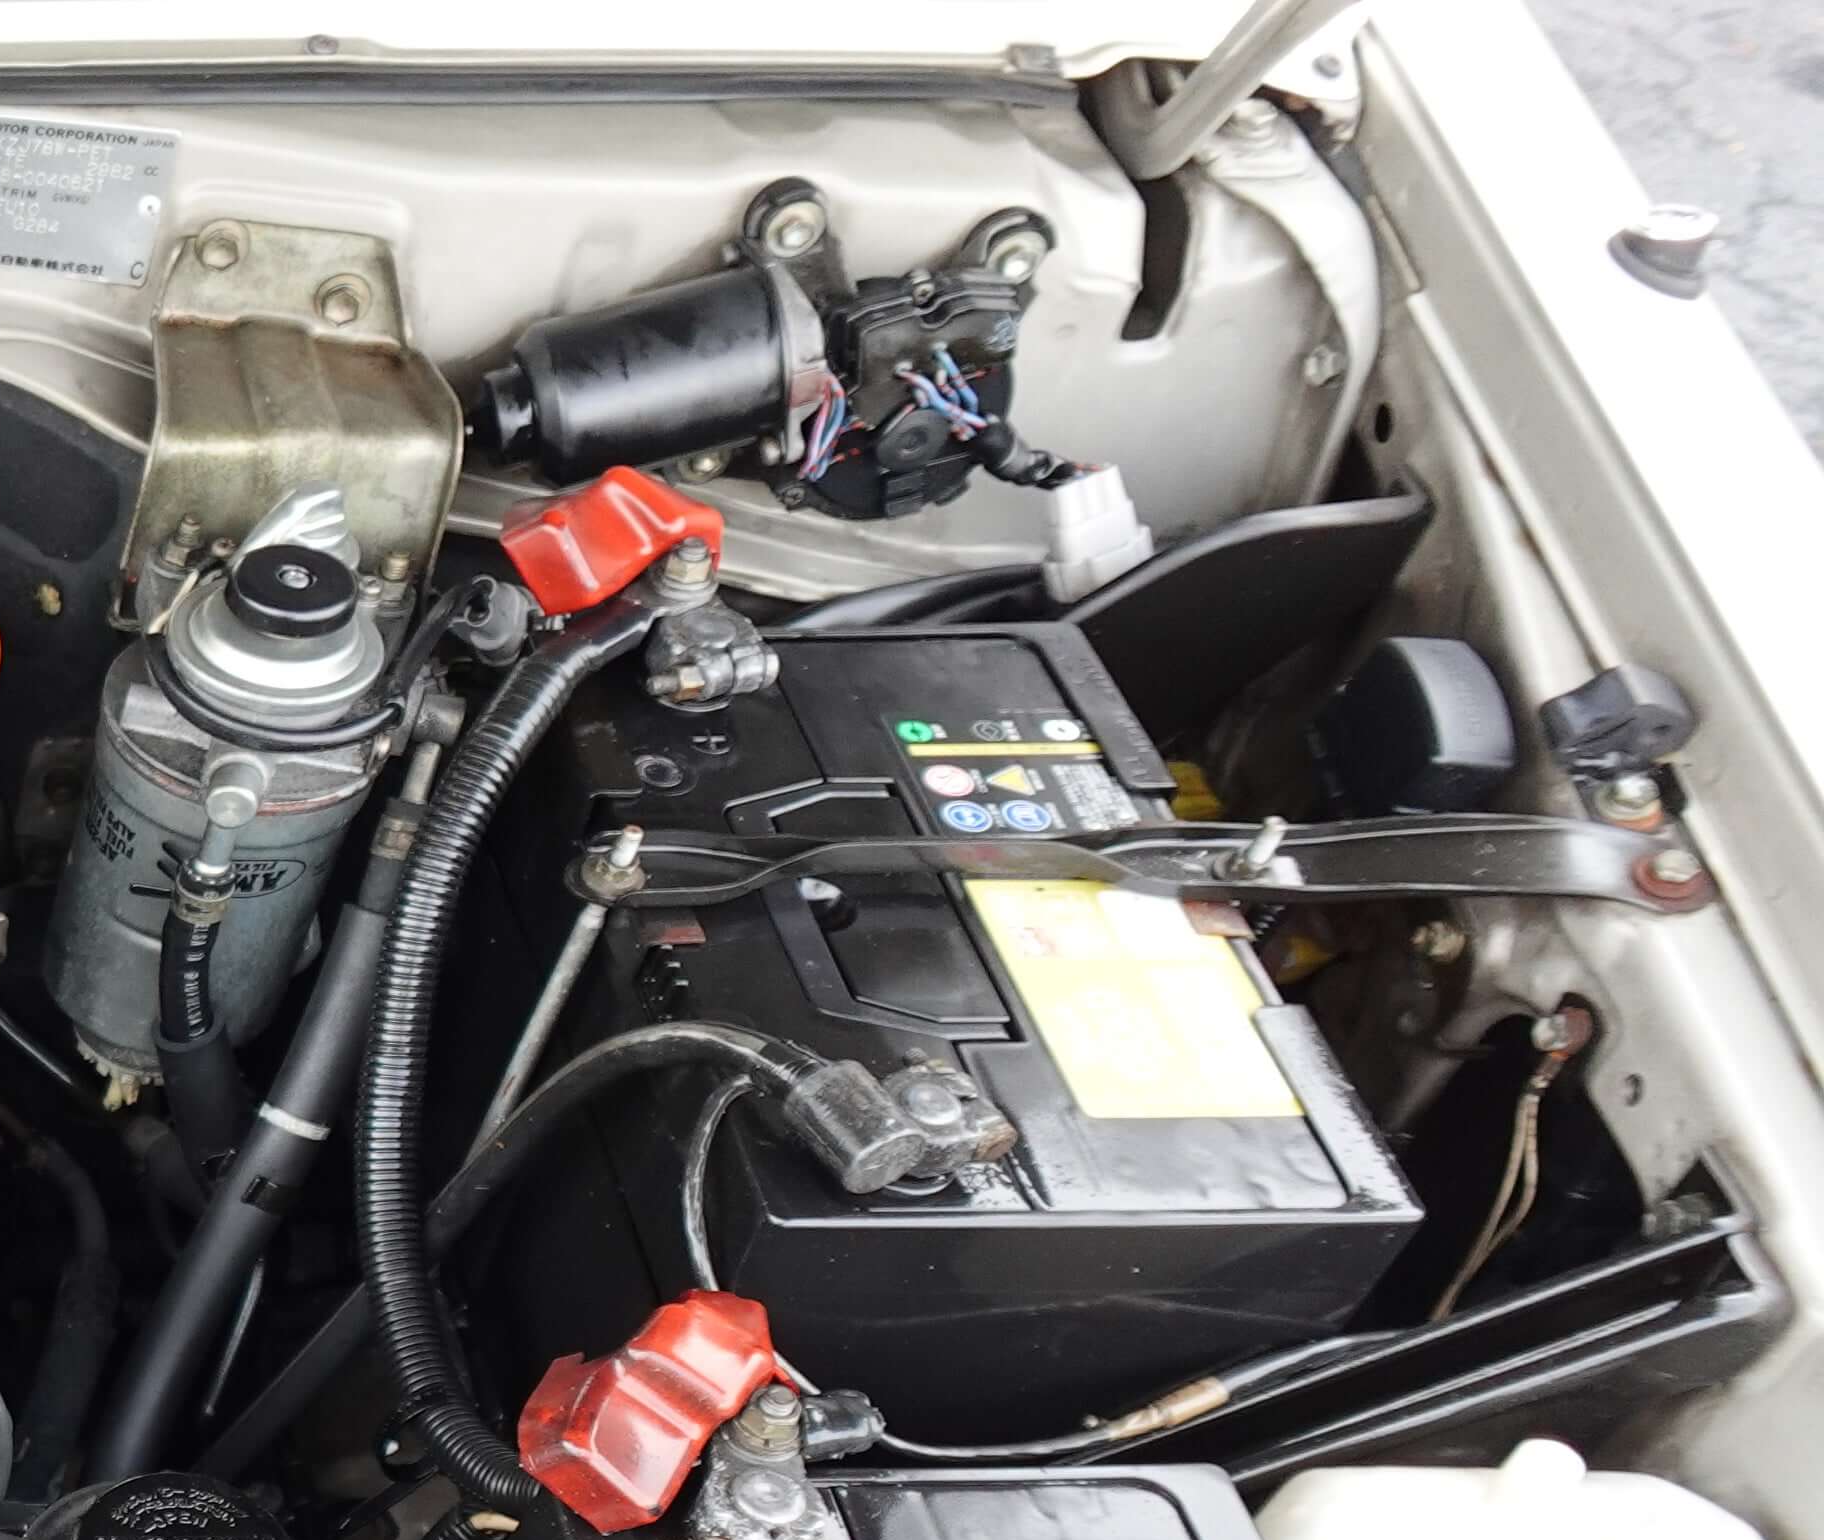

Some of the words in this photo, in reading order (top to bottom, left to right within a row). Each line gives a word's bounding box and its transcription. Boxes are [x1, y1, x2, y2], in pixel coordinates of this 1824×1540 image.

[35, 125, 138, 145] CORPORATION
[142, 138, 176, 148] JAPAN
[2, 187, 38, 198] TRIM
